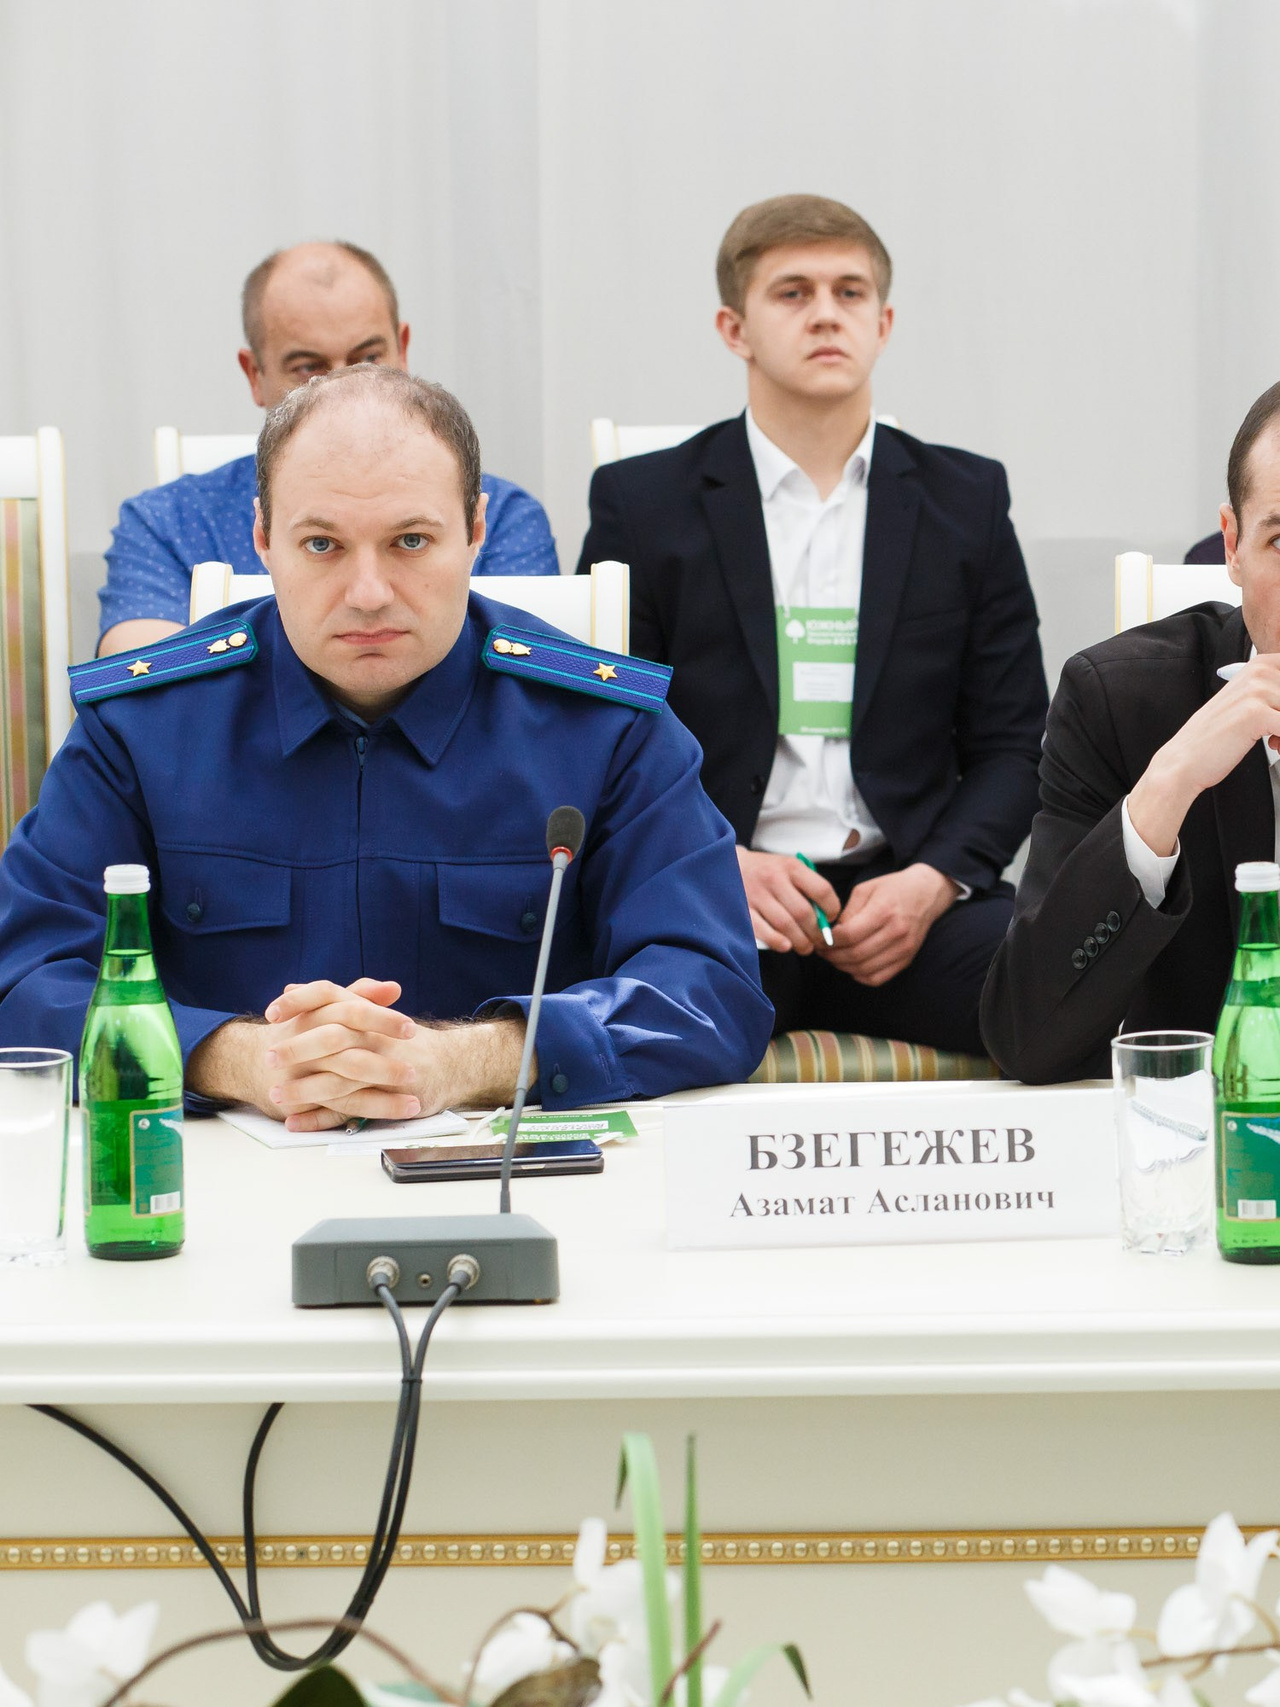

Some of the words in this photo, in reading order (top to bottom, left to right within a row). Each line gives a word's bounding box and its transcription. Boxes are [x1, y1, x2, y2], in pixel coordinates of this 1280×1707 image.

[747, 1127, 1036, 1171] БЗЕГЕЖЕВ
[729, 1192, 856, 1218] Азамат
[867, 1188, 1055, 1214] Асланович
